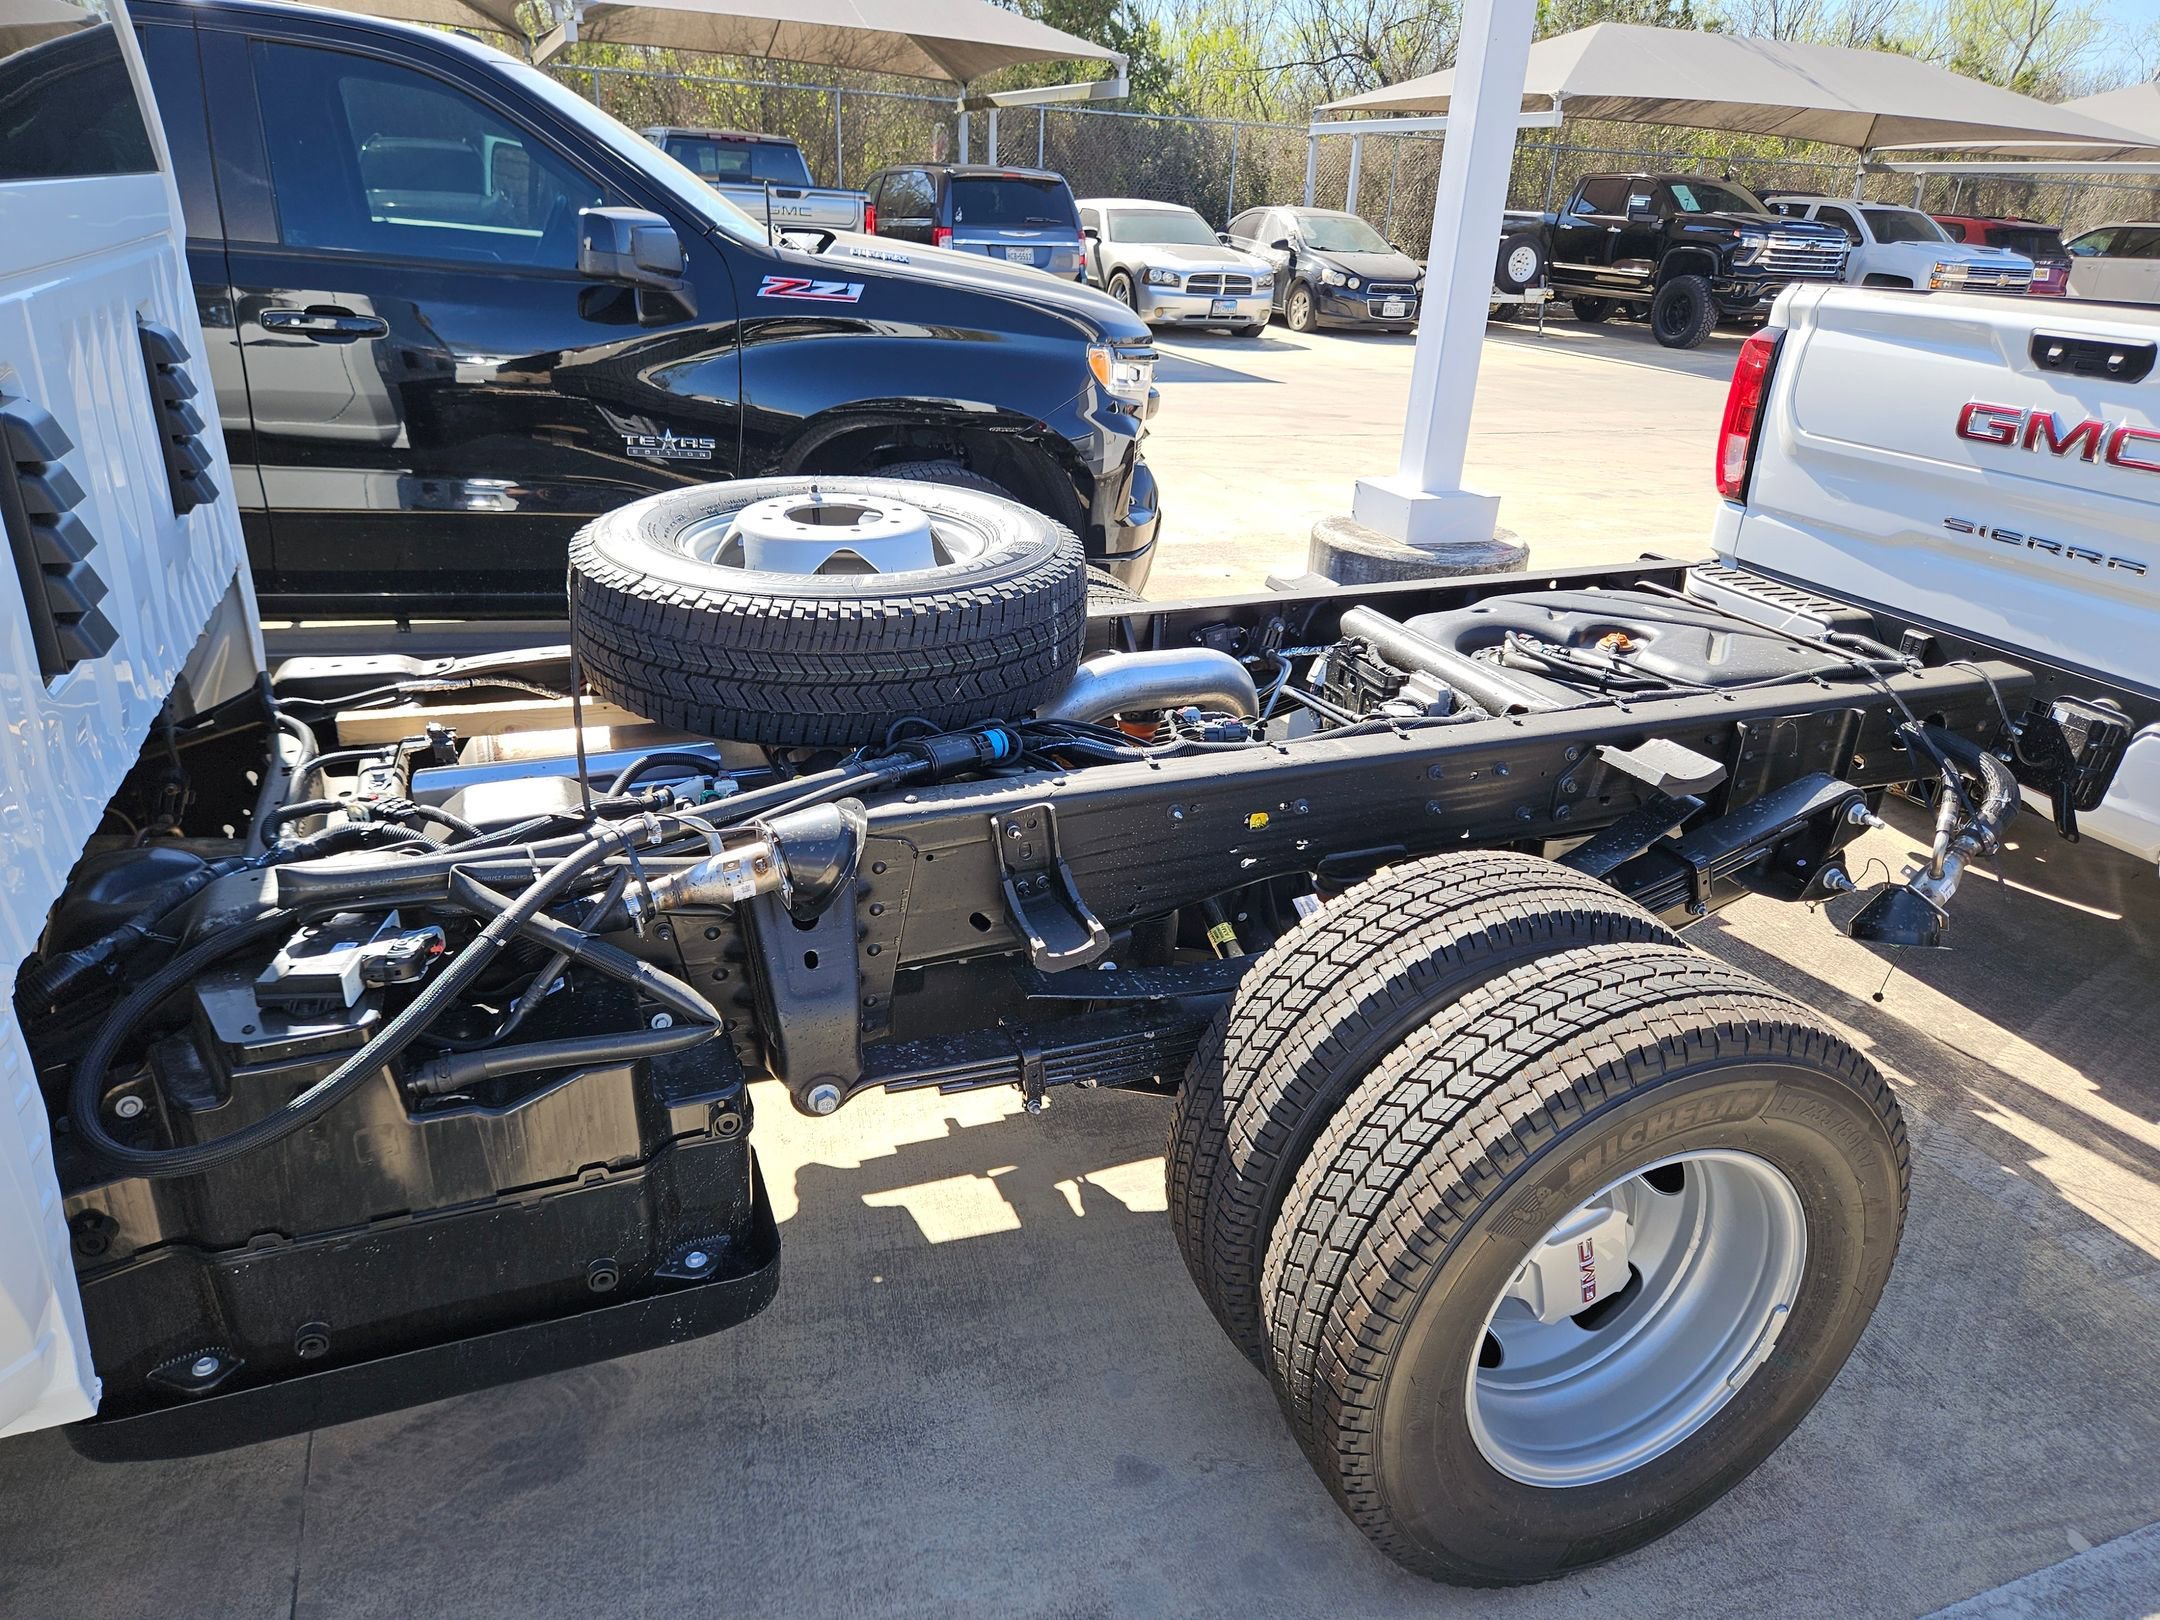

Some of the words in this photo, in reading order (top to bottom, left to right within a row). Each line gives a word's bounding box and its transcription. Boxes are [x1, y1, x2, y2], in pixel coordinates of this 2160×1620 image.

[756, 275, 865, 303] Z71
[621, 430, 716, 450] TEXAS
[1955, 401, 2160, 474] GMC
[1942, 516, 2148, 577] SIERRA
[1568, 1087, 1762, 1182] MICHELIN
[1578, 1237, 1597, 1303] GMC
